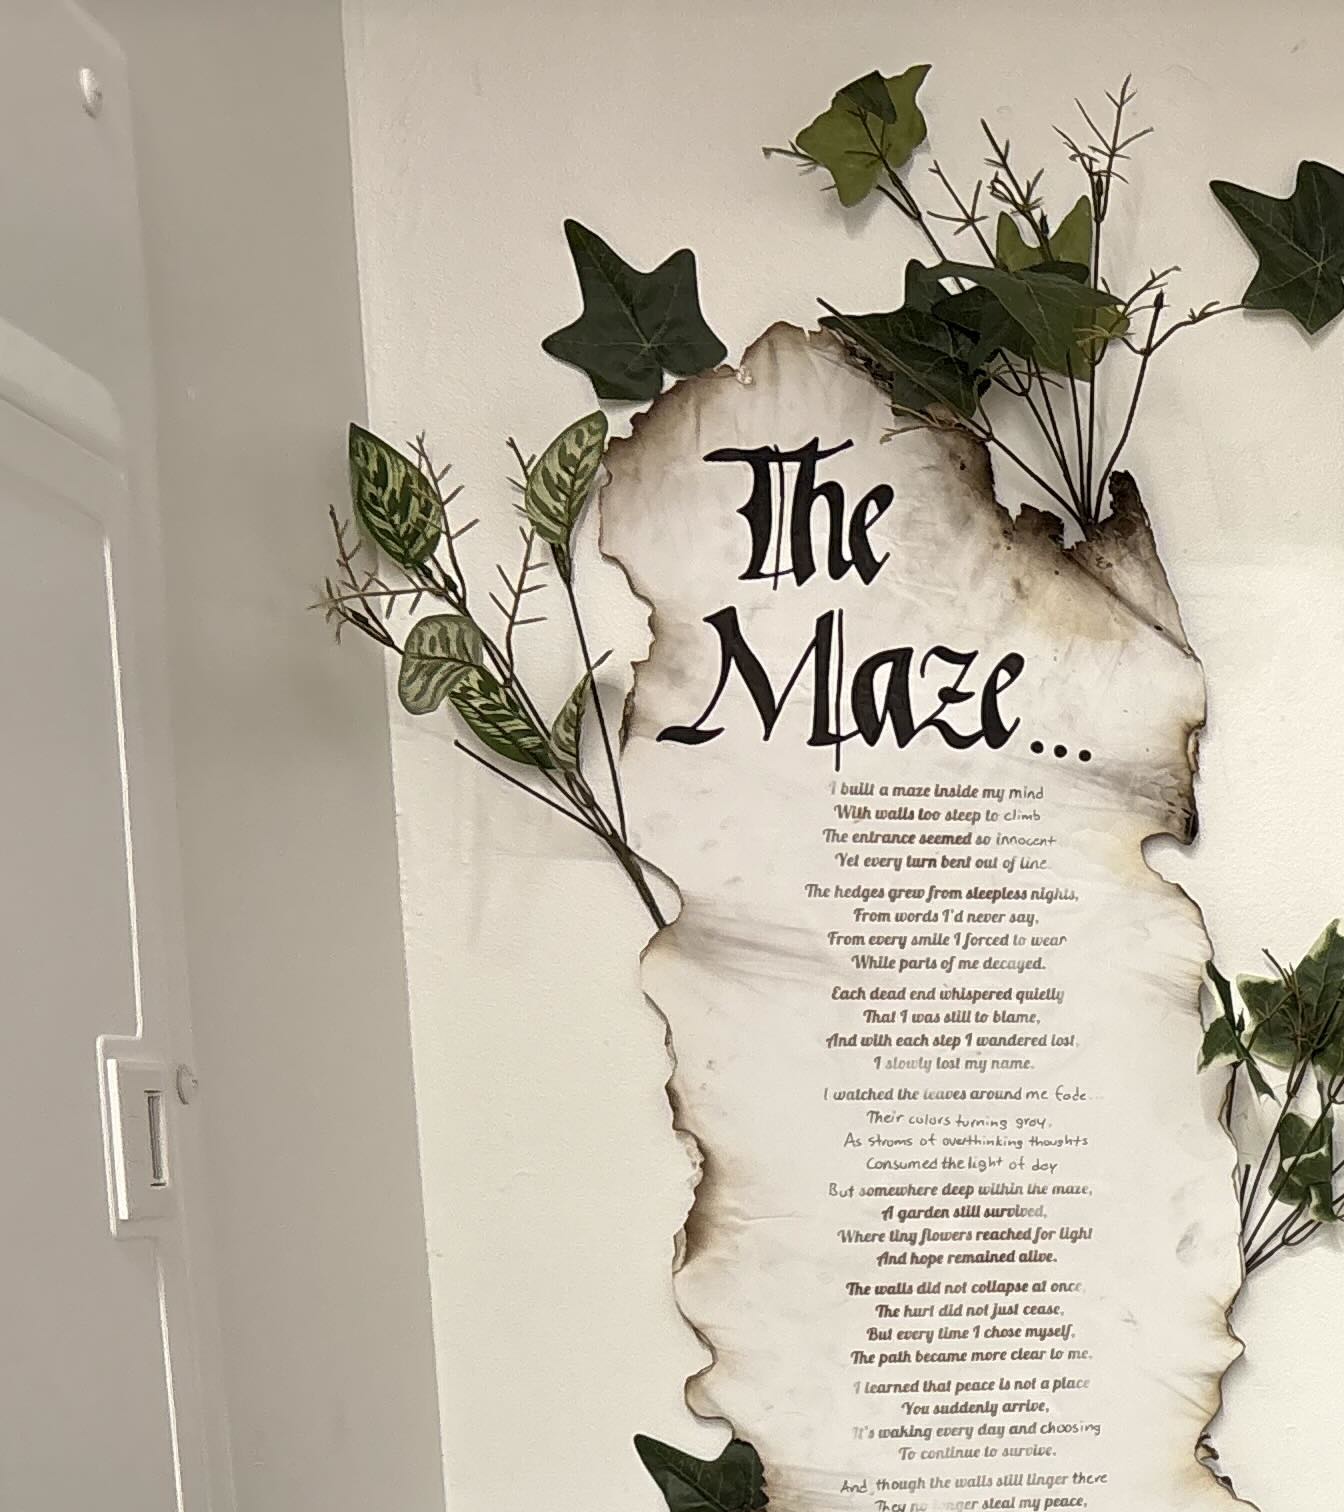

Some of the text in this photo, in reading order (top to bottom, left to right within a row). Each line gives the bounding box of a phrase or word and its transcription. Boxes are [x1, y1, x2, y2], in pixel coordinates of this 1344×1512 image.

[703, 436, 894, 590] The
[657, 606, 1092, 771] Maze...
[840, 782, 1043, 803] built maze inside my mind
[834, 804, 1040, 826] With walls too steep climb
[822, 828, 1057, 846] The entrance seemed innocent
[835, 853, 998, 872] Yet every turn bent out
[805, 884, 830, 897] The
[834, 885, 884, 902] hedges
[888, 889, 925, 902] grew
[925, 885, 962, 903] from
[966, 887, 1027, 904] sleepless
[853, 908, 891, 922] From
[895, 910, 938, 922] words
[967, 913, 1006, 923] never
[1009, 913, 1039, 927] say,
[827, 931, 1067, 950] From every smile forced wear
[851, 955, 1046, 974] While parts of me decayed.
[832, 986, 1064, 1004] Each dead end whispered quietly
[863, 1009, 896, 1023] That
[912, 1013, 940, 1023] was
[944, 1010, 971, 1023] still
[826, 1033, 1047, 1050] And with each step wandered
[936, 1057, 960, 1069] lost
[965, 1060, 987, 1073] my
[833, 1087, 1048, 1100] watched the around me
[866, 1110, 904, 1123] Their
[955, 1114, 1007, 1130] turning
[844, 1132, 862, 1147] As
[920, 1133, 936, 1146] of
[1028, 1135, 1088, 1147] thoughts
[866, 1157, 937, 1170] Consumed
[941, 1157, 965, 1169] the
[968, 1156, 1003, 1172] light
[1009, 1156, 1025, 1170] of
[829, 1182, 1048, 1199] But somewhere deep within the
[897, 1205, 981, 1223] garden still
[837, 1227, 1093, 1246] Where tiny flowers reached for light
[876, 1250, 1057, 1269] And hope remained alive.
[846, 1280, 1047, 1296] The walls did not collapse at
[875, 1303, 1019, 1320] The hurt did not just
[866, 1326, 1022, 1344] But every time chose
[851, 1348, 1046, 1367] The path became more clear
[864, 1380, 919, 1393] learned
[923, 1380, 951, 1392] that
[955, 1381, 995, 1396] peace
[1014, 1378, 1036, 1390] not
[901, 1399, 1049, 1417] You suddenly arrive,
[878, 1425, 932, 1441] waking
[936, 1427, 974, 1440] every
[1009, 1422, 1037, 1435] and
[1040, 1421, 1100, 1436] choosing
[898, 1447, 916, 1460] To
[920, 1446, 980, 1460] continue
[984, 1446, 998, 1457] to
[876, 1472, 1107, 1493] though the walls still linger there
[982, 1497, 1015, 1510] steal
[1019, 1499, 1041, 1512] my
